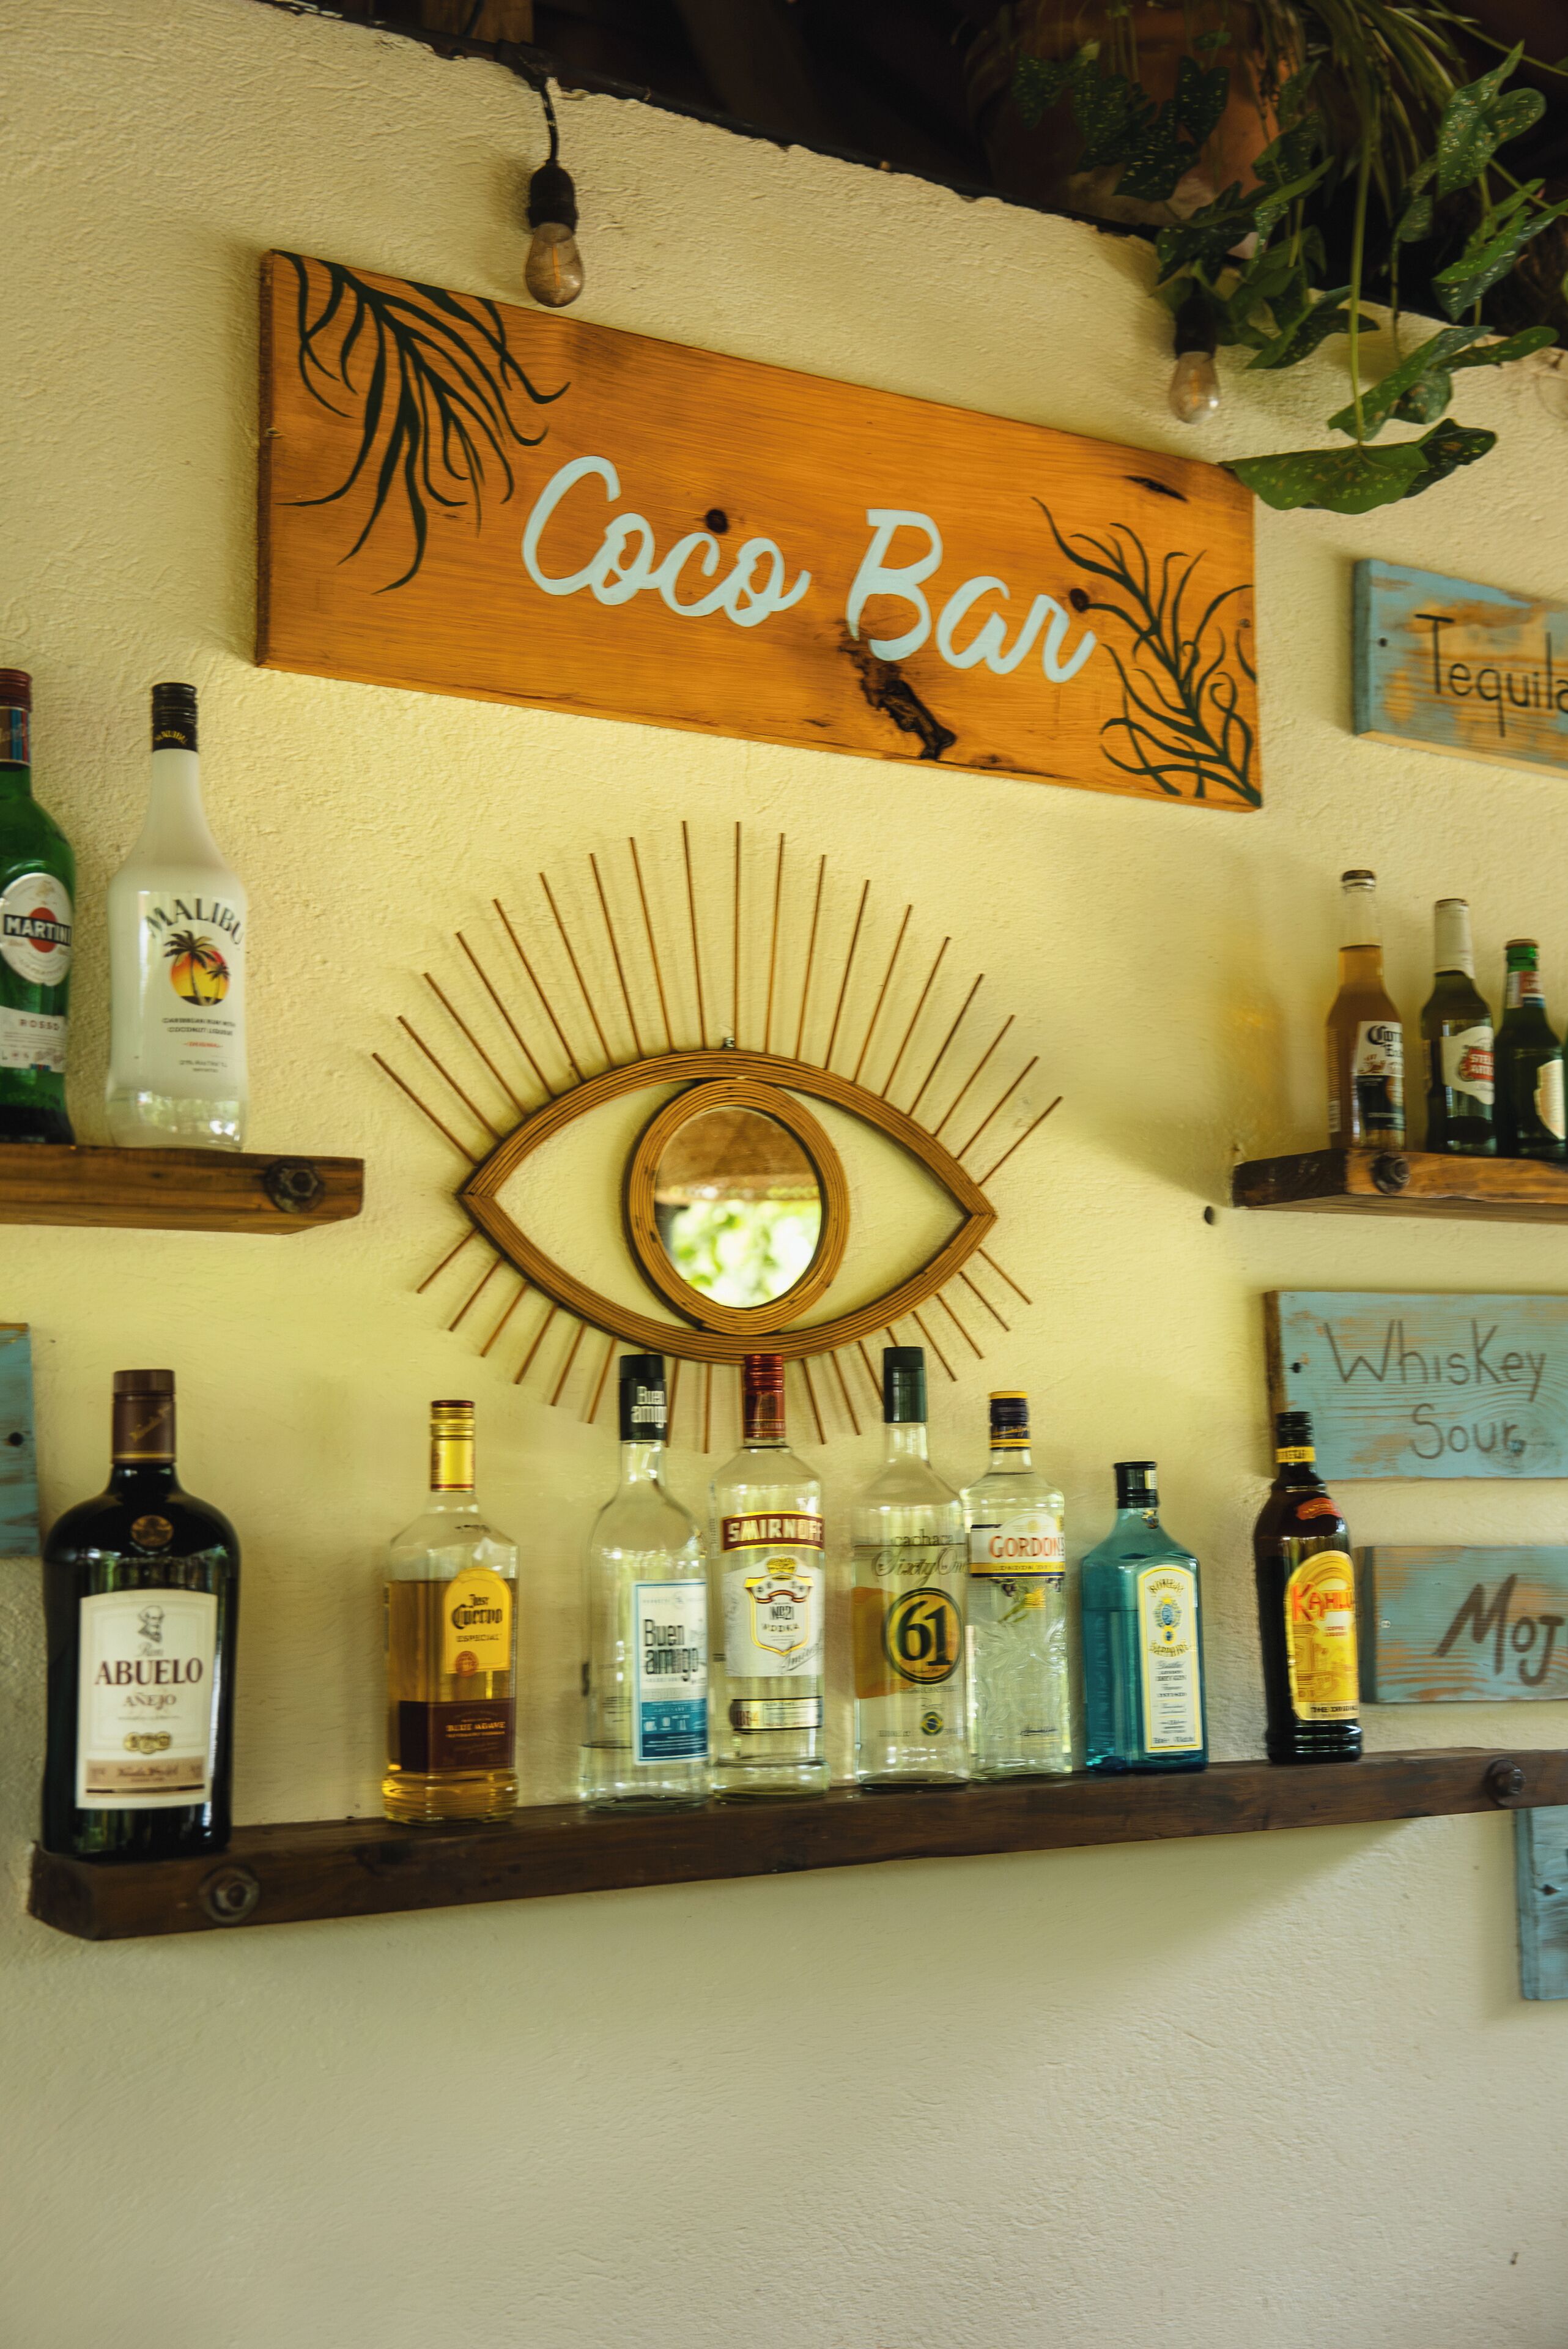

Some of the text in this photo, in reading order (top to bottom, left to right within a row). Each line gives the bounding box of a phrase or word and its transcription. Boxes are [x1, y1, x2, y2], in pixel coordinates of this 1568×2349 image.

[522, 456, 1097, 683] Coco Bar
[145, 897, 244, 945] MALIBU
[19, 1019, 59, 1031] ROSSO
[1410, 1403, 1518, 1460] Sour
[728, 1519, 823, 1542] SMIRNOFF
[452, 1604, 503, 1630] Cuervo
[643, 1619, 685, 1646] Buen
[896, 1600, 952, 1666] 61
[94, 1657, 204, 1685] ABUELO
[124, 1692, 177, 1710] AÑEJO
